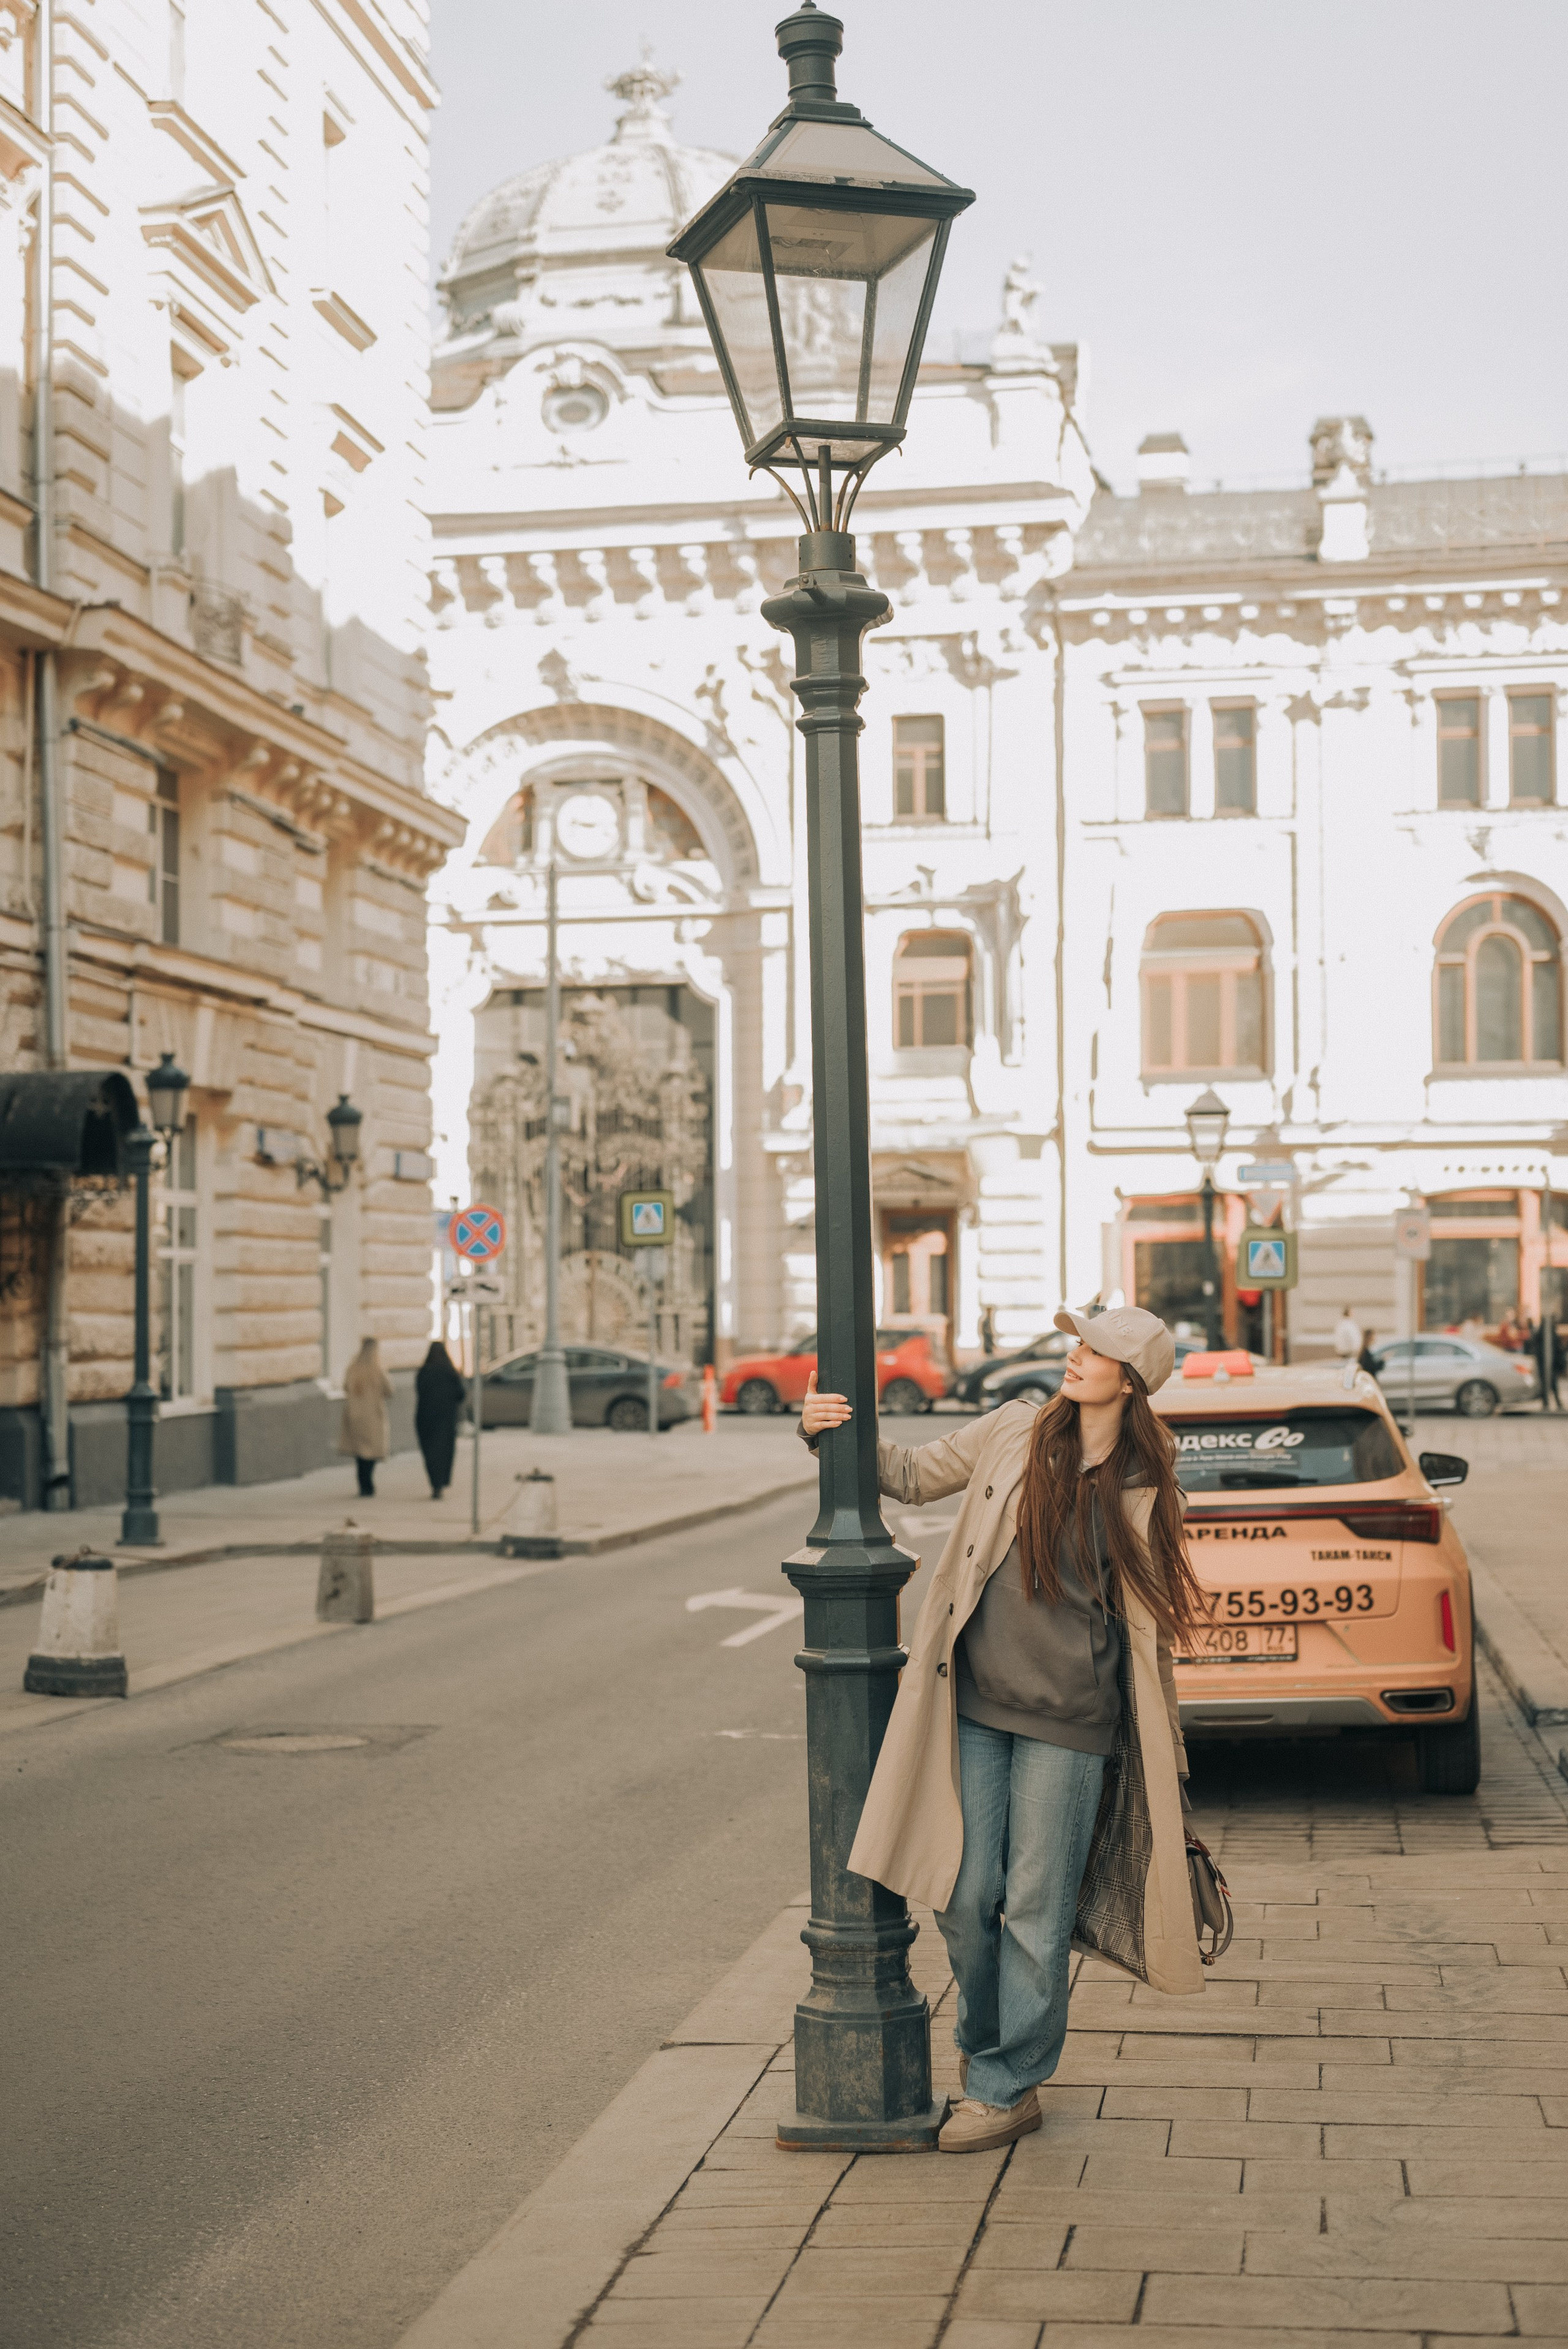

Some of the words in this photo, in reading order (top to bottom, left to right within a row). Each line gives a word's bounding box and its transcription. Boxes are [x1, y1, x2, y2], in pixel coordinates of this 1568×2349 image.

[1254, 1426, 1305, 1450] Go
[1205, 1628, 1248, 1652] 408
[1264, 1627, 1286, 1645] 77
